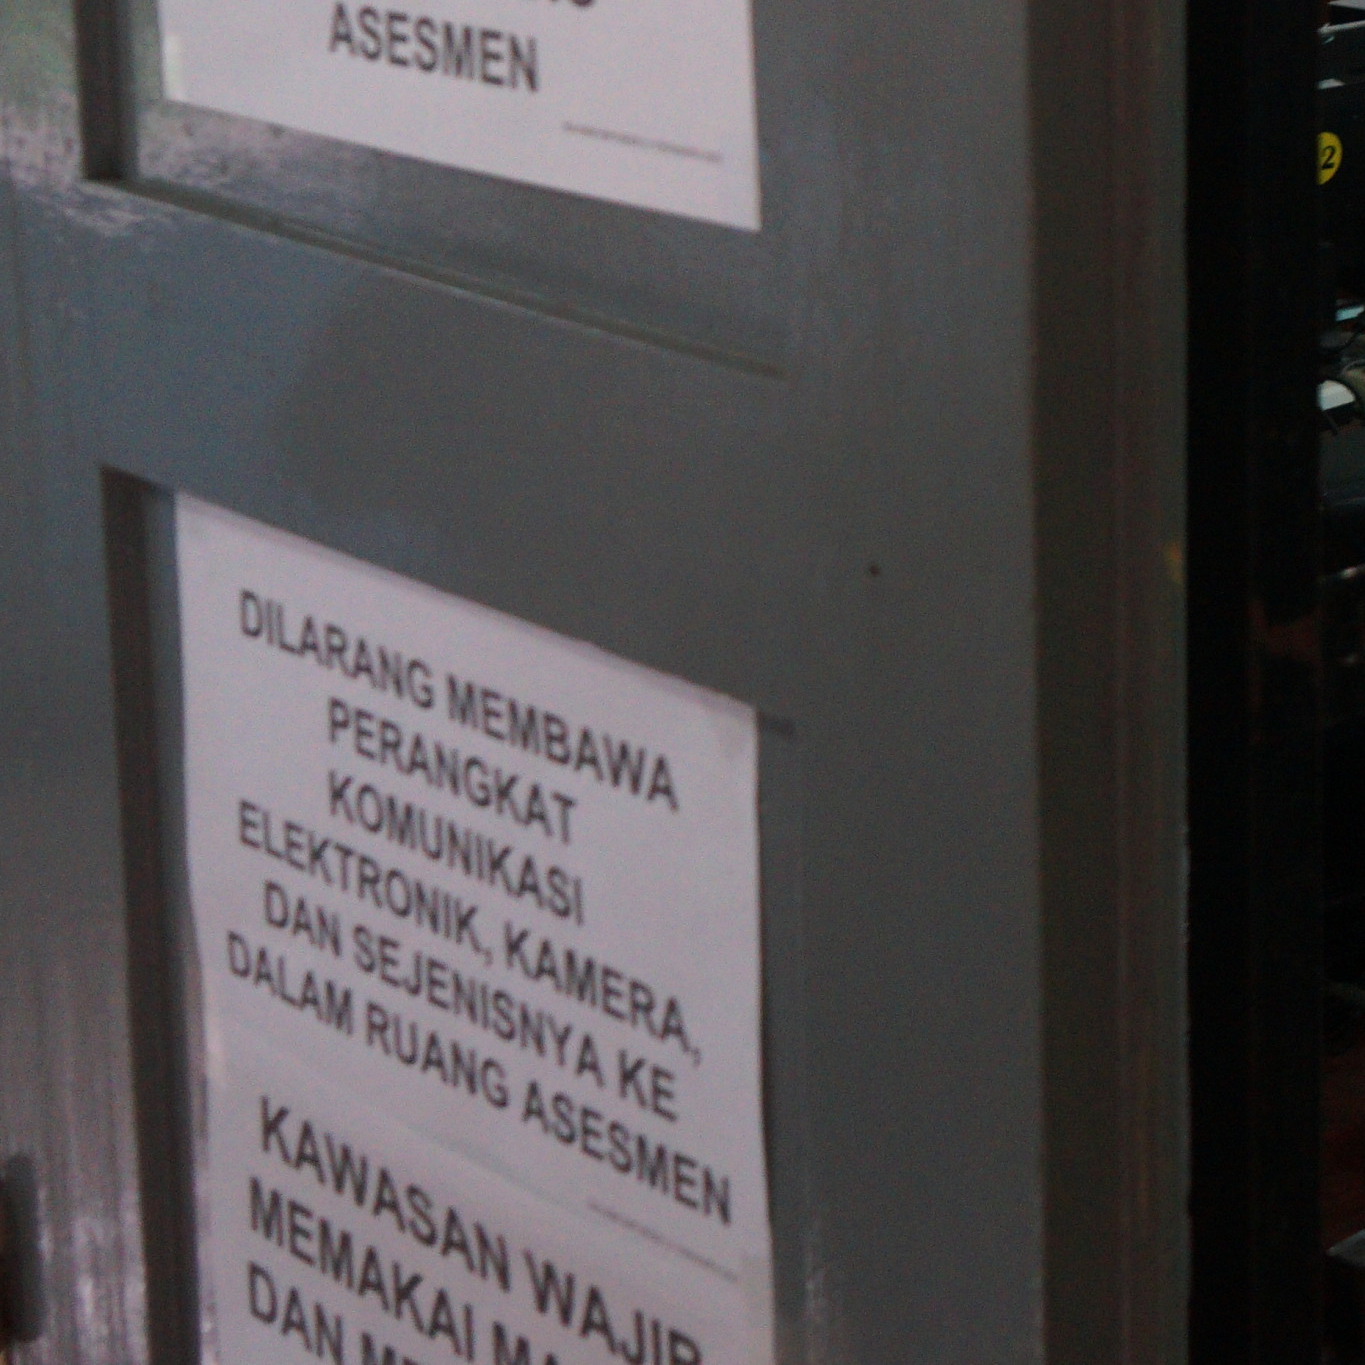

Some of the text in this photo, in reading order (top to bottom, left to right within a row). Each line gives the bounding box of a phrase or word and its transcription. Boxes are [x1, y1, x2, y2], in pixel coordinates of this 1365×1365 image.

[329, 0, 539, 93] ASESMEN
[239, 589, 679, 811] DILARANG MEMBAWA
[328, 696, 577, 845] PERANGKAT
[238, 799, 702, 1068] ELEKTRONIK, KAMERA,
[328, 770, 585, 927] KOMUNIKASI
[226, 931, 732, 1228] DALAM RUANG ASESMEN
[262, 880, 679, 1124] DAN SEJENISNYA KE
[248, 1176, 474, 1362] MEMAKAI
[260, 1095, 510, 1293] KAWASAN
[248, 1261, 343, 1365] DAN
